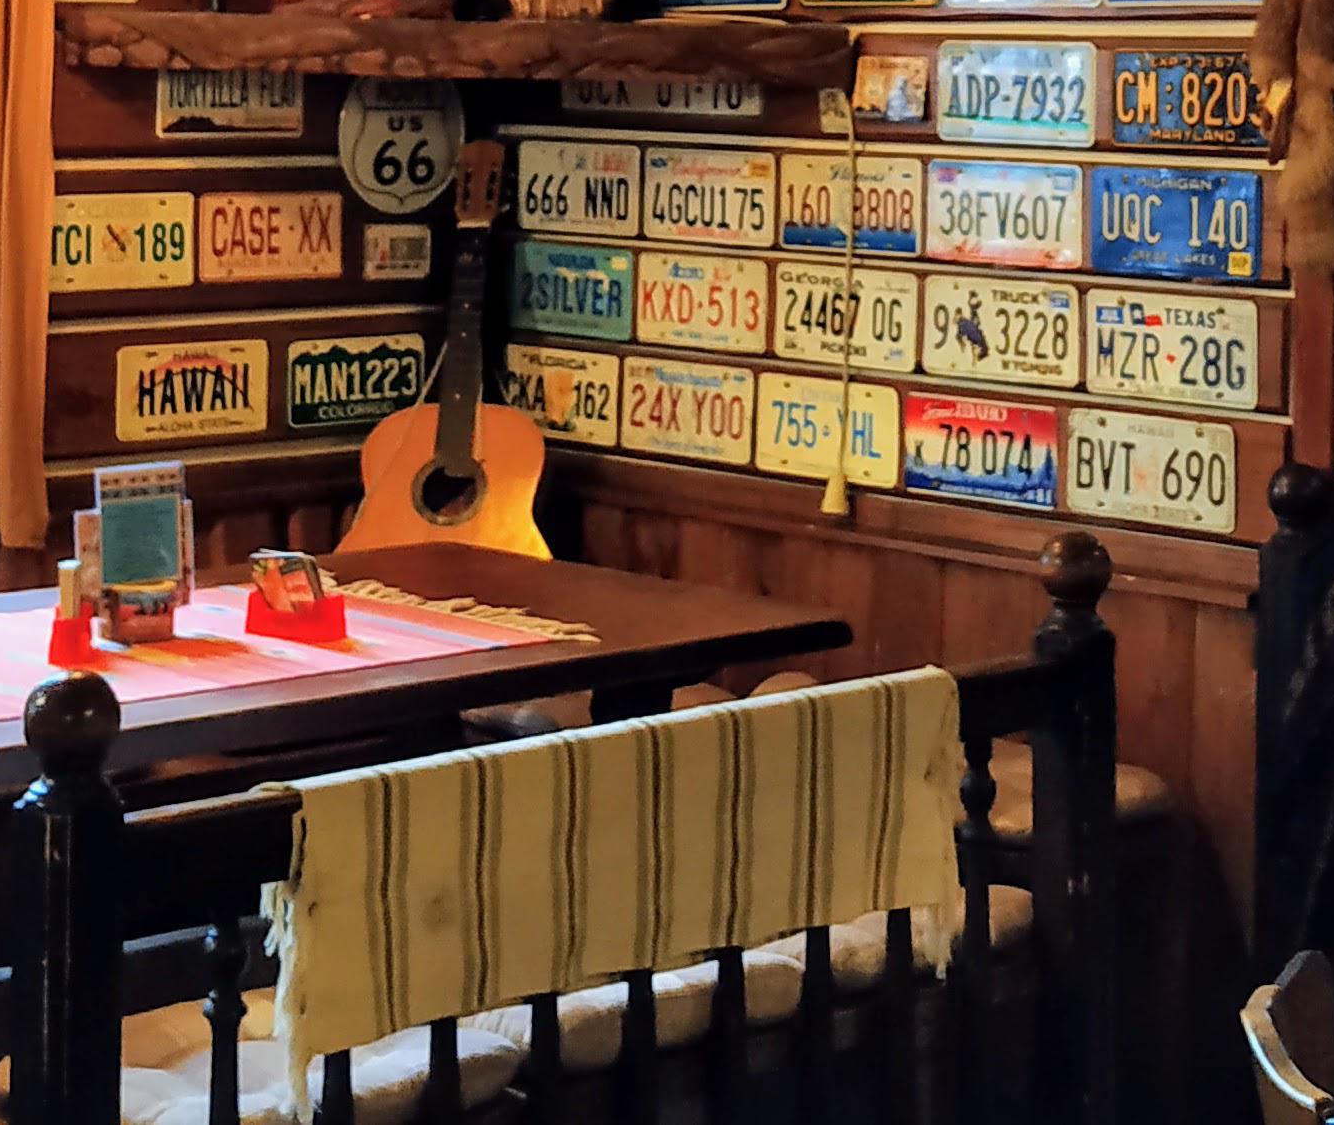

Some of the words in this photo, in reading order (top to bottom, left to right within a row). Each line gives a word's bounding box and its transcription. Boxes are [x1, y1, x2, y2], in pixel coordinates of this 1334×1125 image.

[386, 114, 424, 134] US
[947, 73, 1087, 124] ADP-7932
[1149, 128, 1236, 143] MARYLAND
[372, 138, 436, 187] 66
[1135, 176, 1214, 191] MICHIGAN
[525, 172, 571, 216] 666
[651, 181, 766, 232] 4GCU175
[785, 183, 831, 229] 160
[938, 189, 1068, 242] 38FV607
[133, 220, 186, 263] 189
[210, 205, 282, 259] CASE
[1187, 195, 1250, 251] 140
[779, 269, 866, 290] GEORGA
[990, 288, 1041, 305] TRUCK
[783, 287, 861, 340] 24467
[933, 303, 951, 351] 9
[994, 308, 1069, 362] 3228
[1164, 306, 1217, 330] TEXAS
[294, 355, 419, 407] MAN1223
[1096, 327, 1162, 383] MZR
[1179, 334, 1247, 391] 28G
[572, 379, 612, 422] 162
[770, 399, 818, 450] 755
[837, 407, 883, 460] HL
[938, 423, 972, 473] 78
[980, 429, 1034, 480] 074
[1075, 436, 1137, 495] BVT
[1161, 448, 1227, 507] 690
